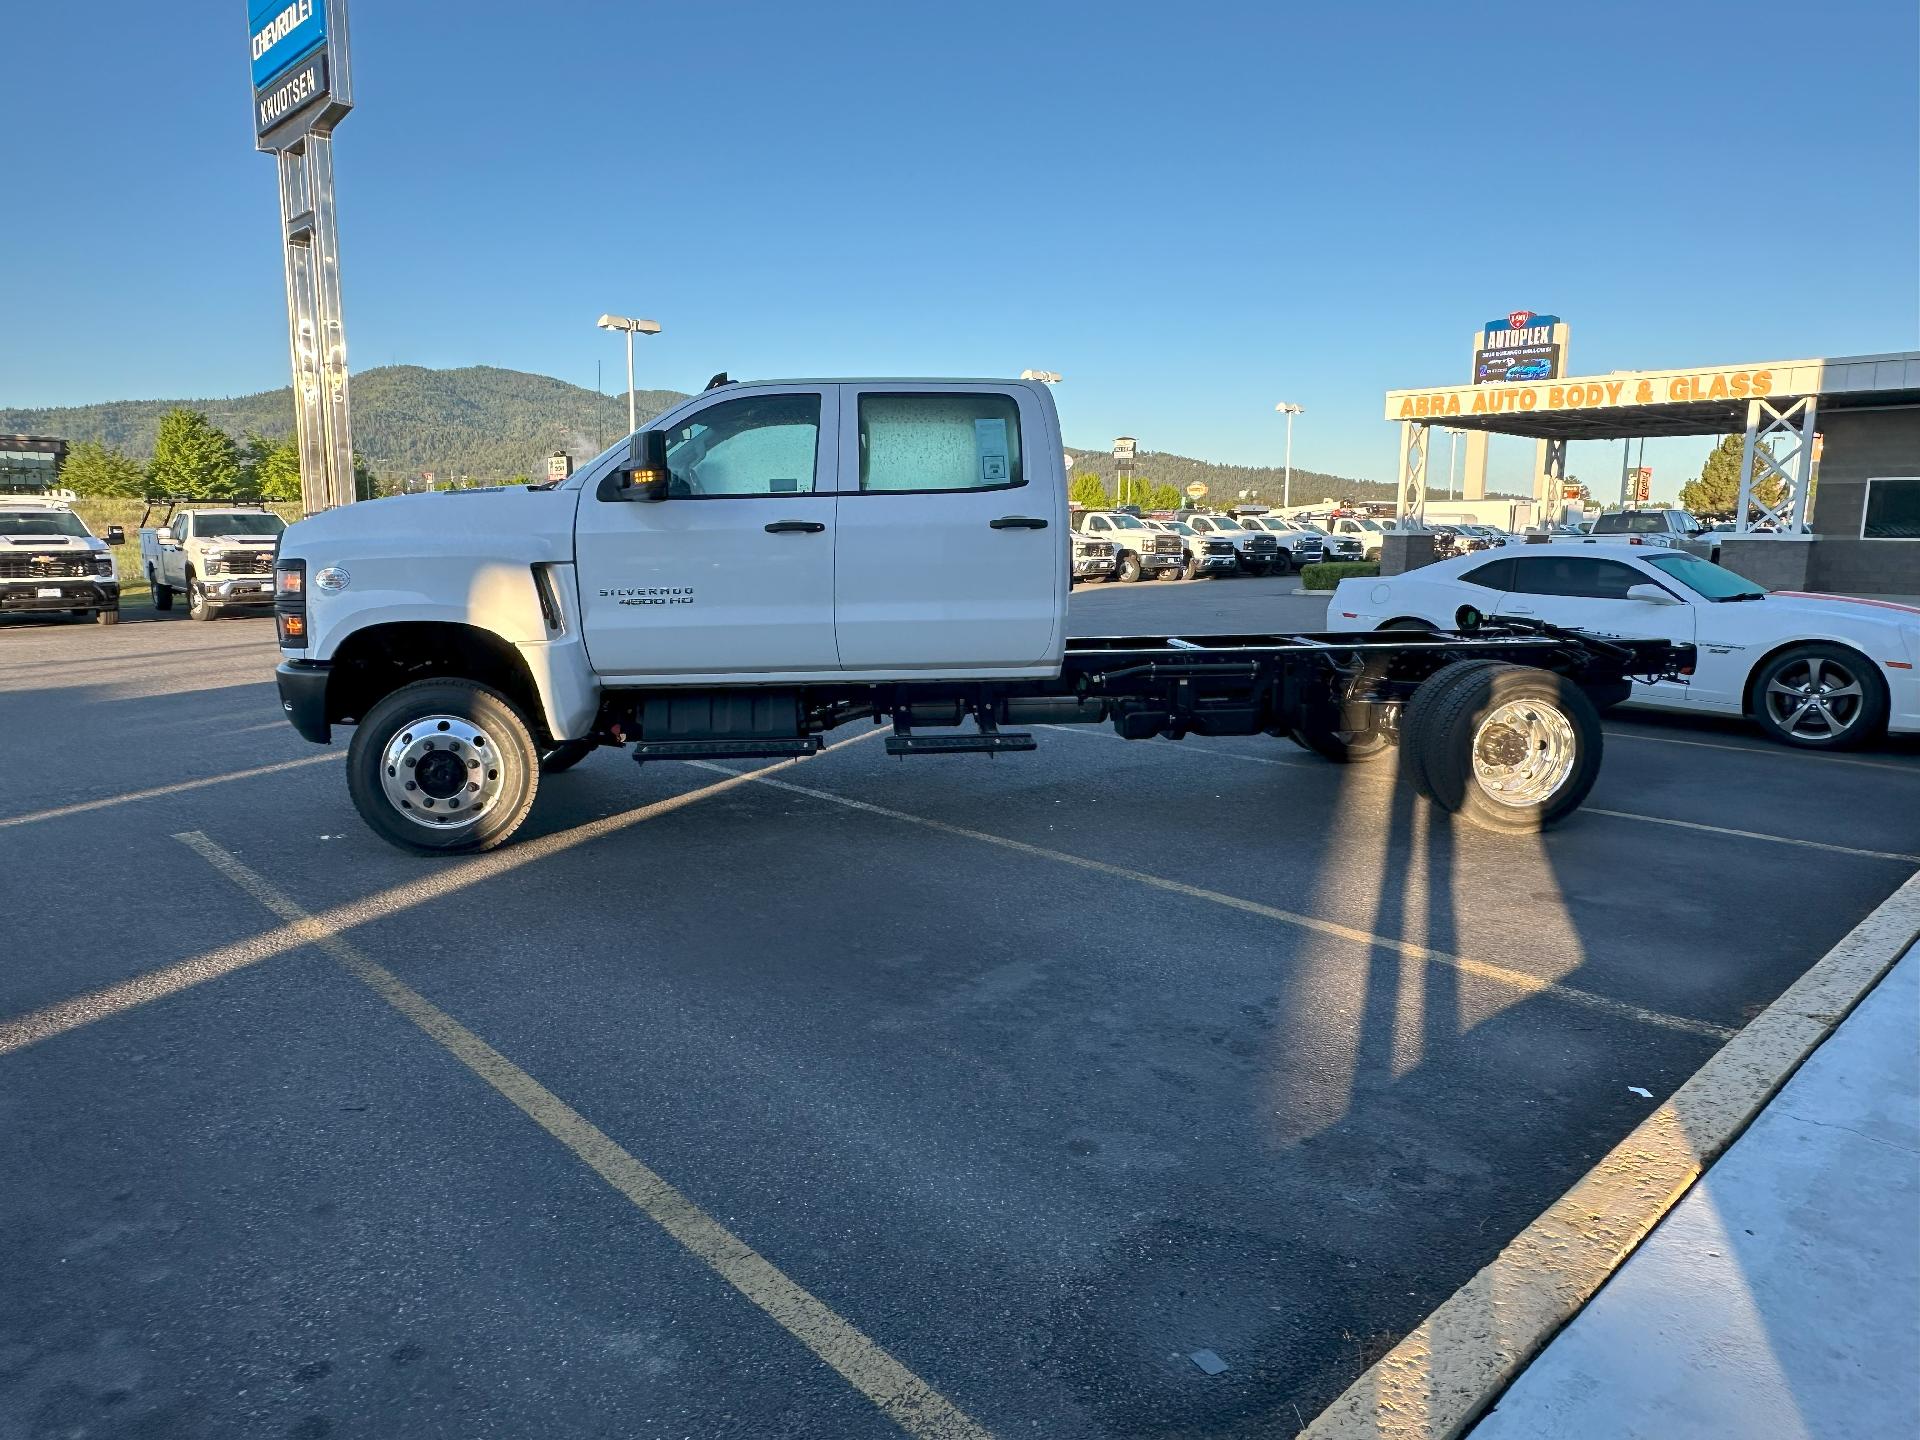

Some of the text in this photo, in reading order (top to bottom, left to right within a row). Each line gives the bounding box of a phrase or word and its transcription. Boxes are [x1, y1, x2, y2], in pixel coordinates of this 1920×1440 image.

[252, 0, 313, 61] CHEVROLET
[260, 67, 316, 126] KNUDTSEN
[1487, 326, 1550, 350] AUTOPLEX
[1400, 370, 1773, 417] ABRA AUTO BODY & GLASS
[599, 587, 694, 597] SILVERADO
[669, 596, 694, 605] HD
